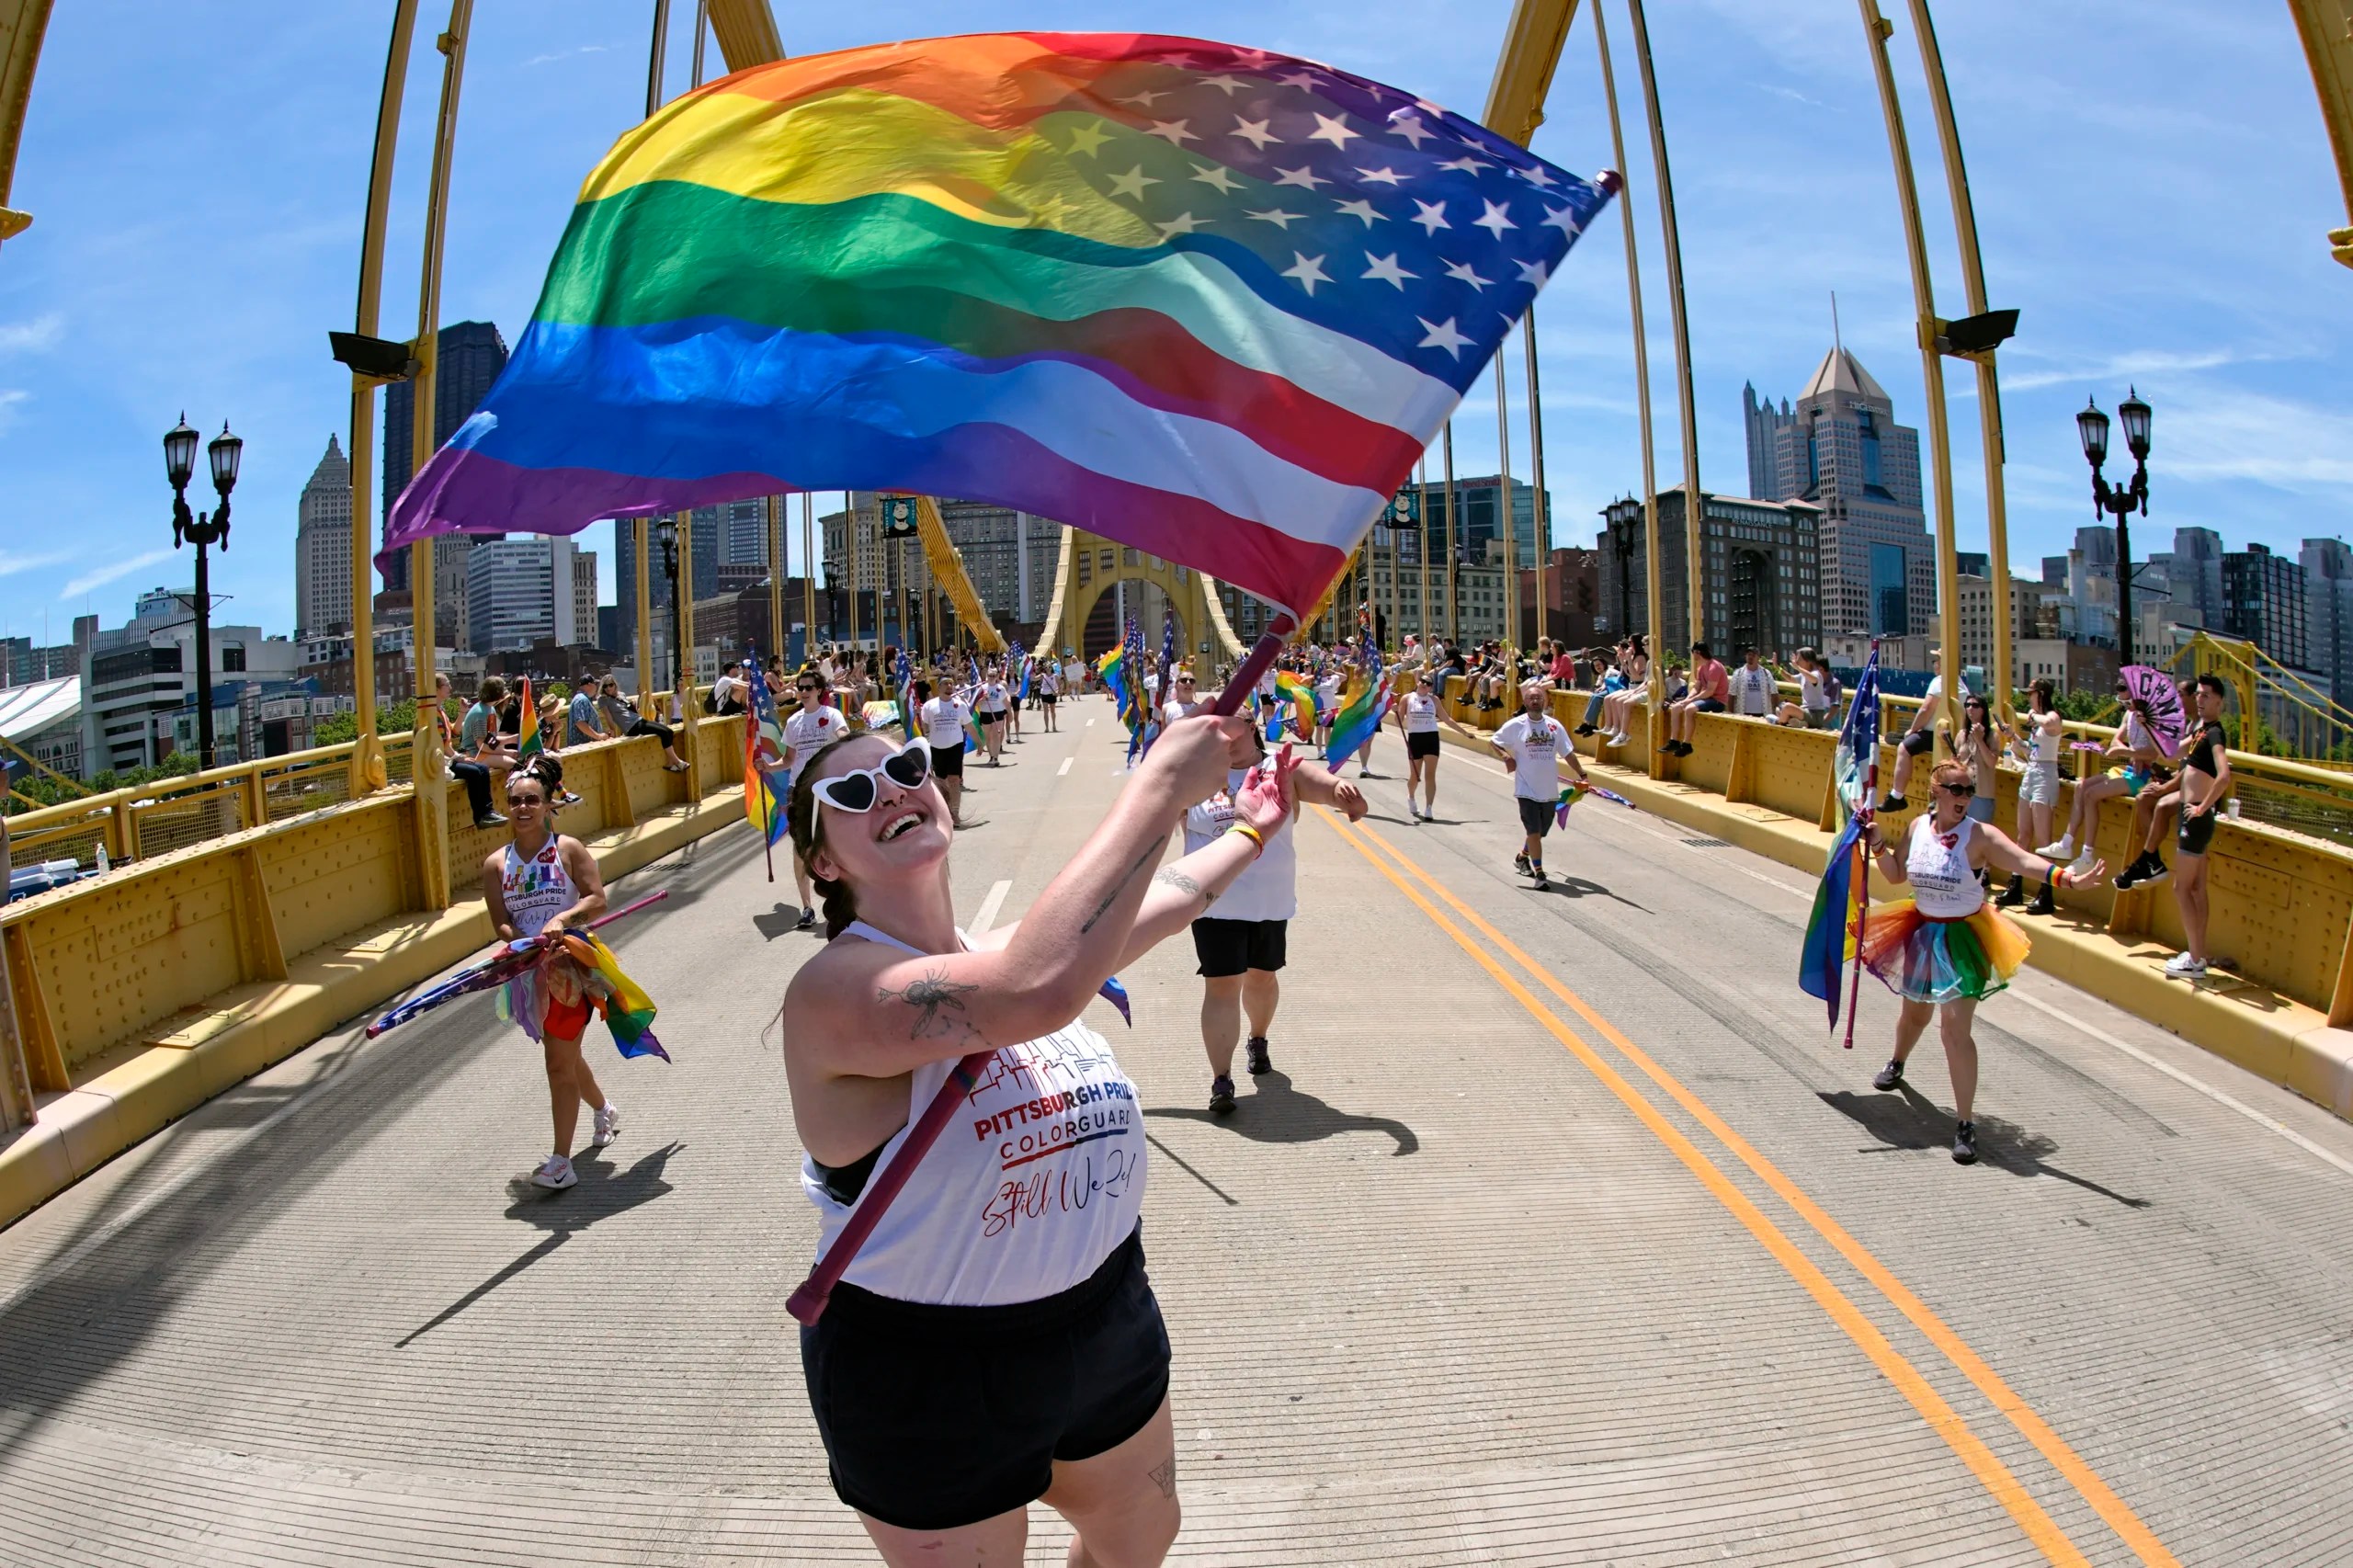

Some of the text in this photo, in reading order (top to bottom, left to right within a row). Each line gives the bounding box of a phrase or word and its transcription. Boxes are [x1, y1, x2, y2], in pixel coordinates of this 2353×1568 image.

[545, 888, 566, 896] PRIDE
[1940, 876, 1961, 884] PRIDE
[974, 1084, 1102, 1142] PITTSBURGH
[982, 1169, 1053, 1237] Still
[1061, 1156, 1104, 1212] We
